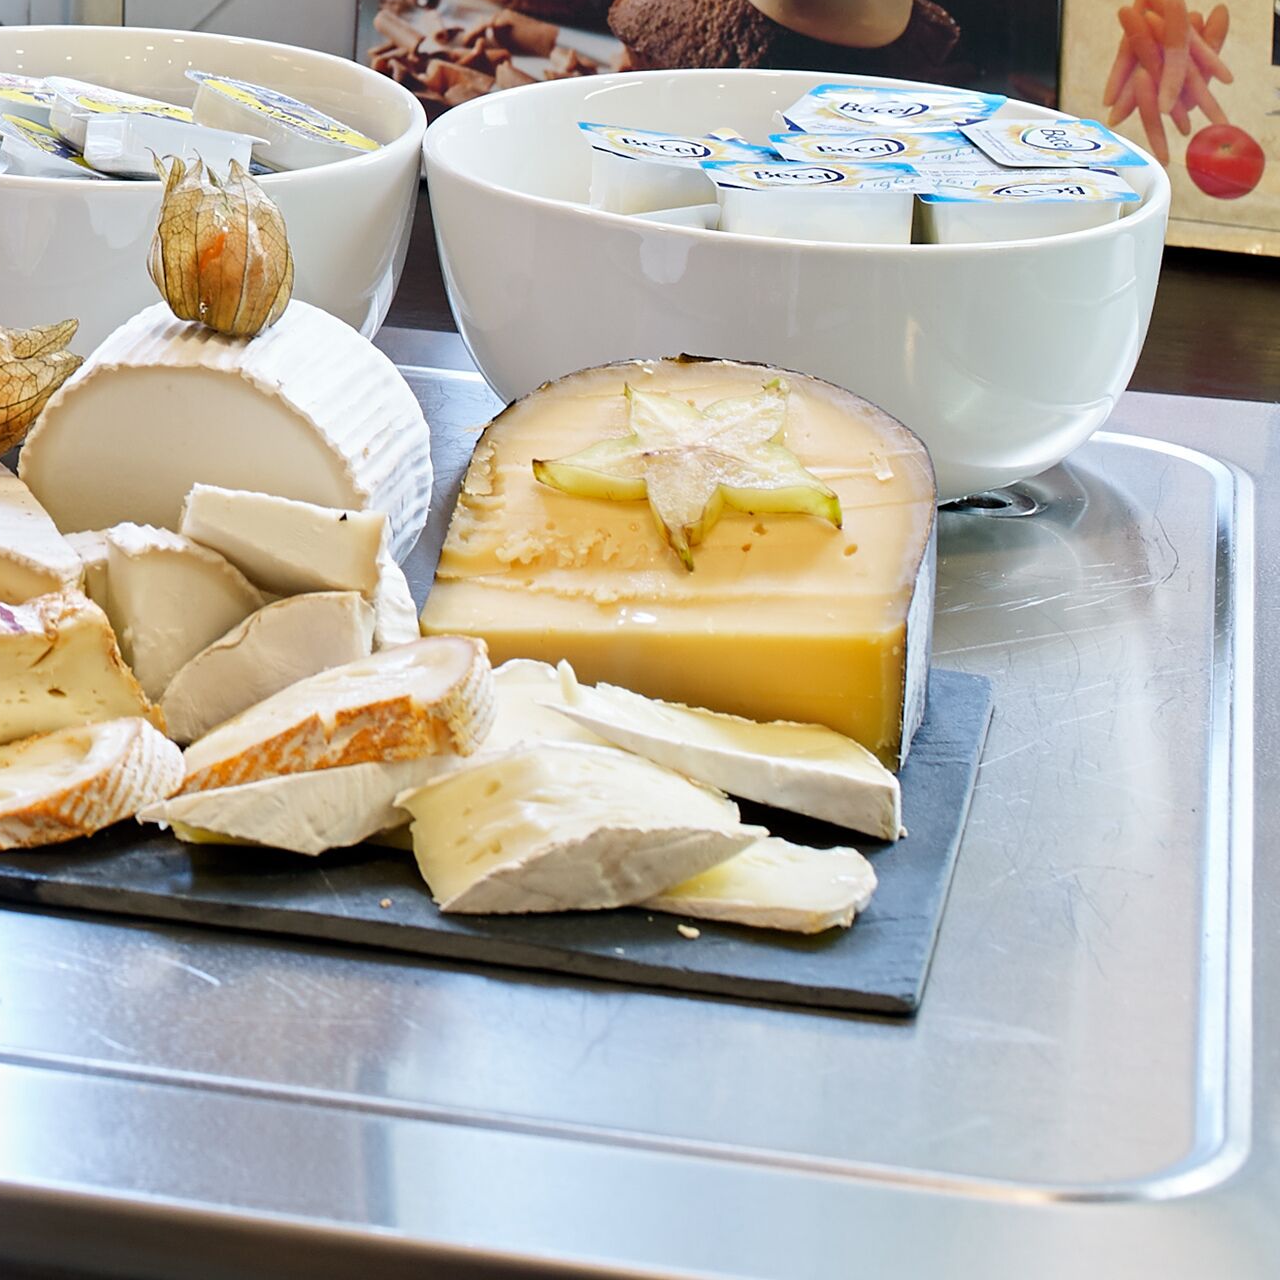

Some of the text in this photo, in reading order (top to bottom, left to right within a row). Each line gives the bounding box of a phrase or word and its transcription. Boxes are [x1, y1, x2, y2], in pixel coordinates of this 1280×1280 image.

[840, 102, 915, 118] Becel
[622, 137, 700, 155] Becel
[817, 143, 893, 153] Becel
[754, 171, 831, 181] Becel
